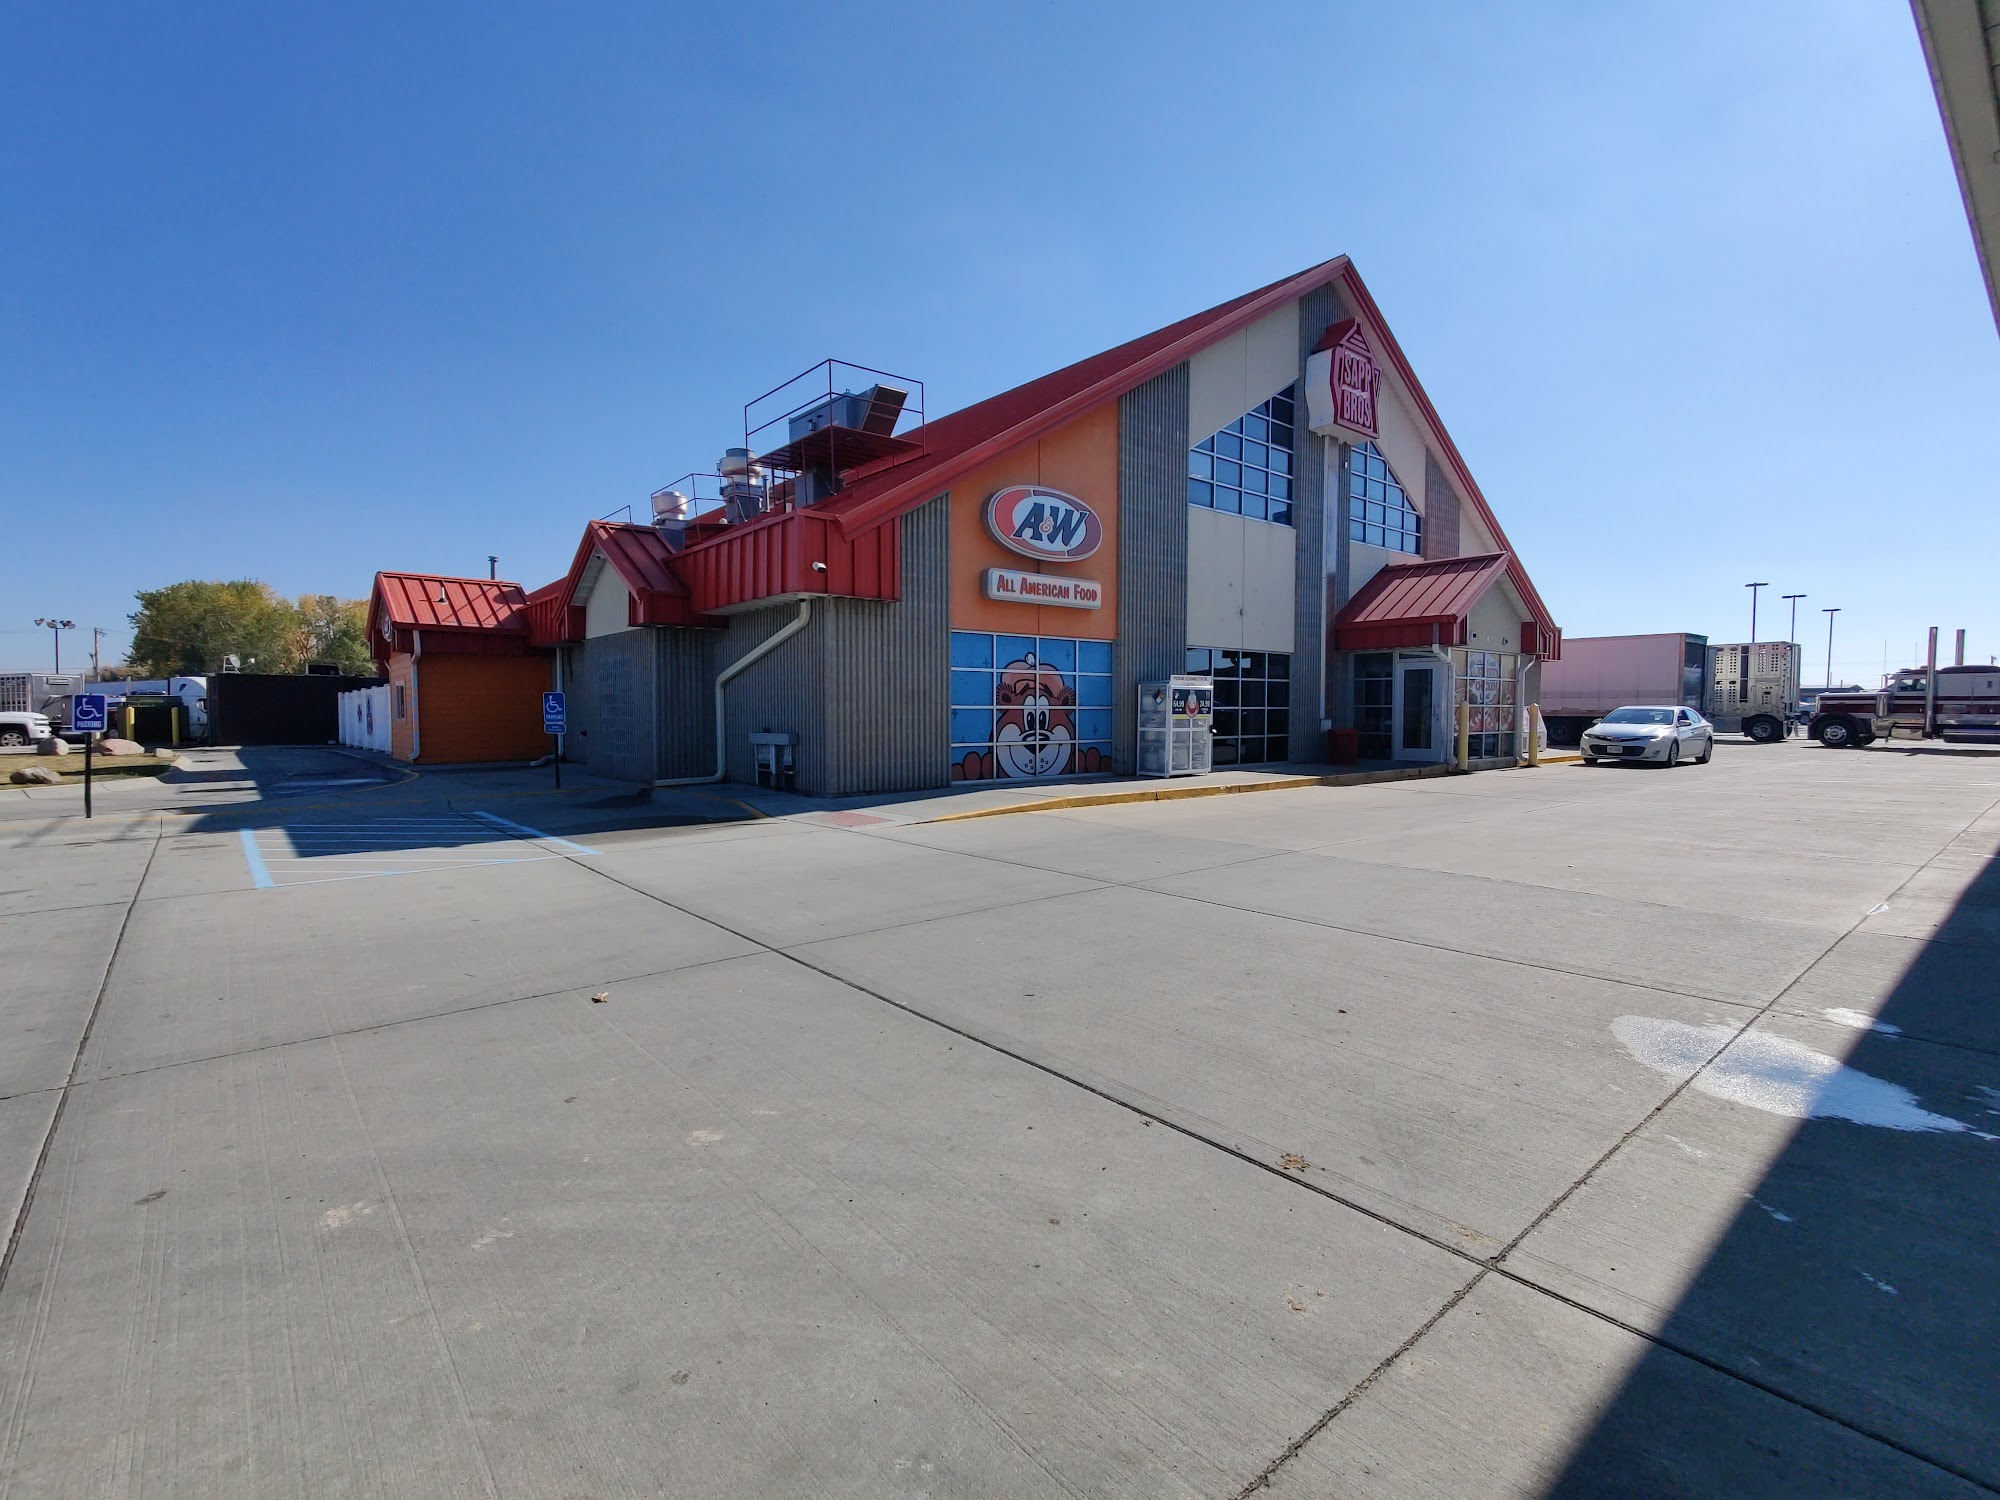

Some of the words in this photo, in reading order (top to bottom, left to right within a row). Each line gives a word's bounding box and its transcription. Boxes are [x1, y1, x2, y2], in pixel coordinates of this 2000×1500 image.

[1345, 354, 1371, 392] SAPP
[1344, 389, 1371, 428] BROS
[1011, 501, 1090, 547] A&W
[1476, 682, 1497, 691] CHCKEN
